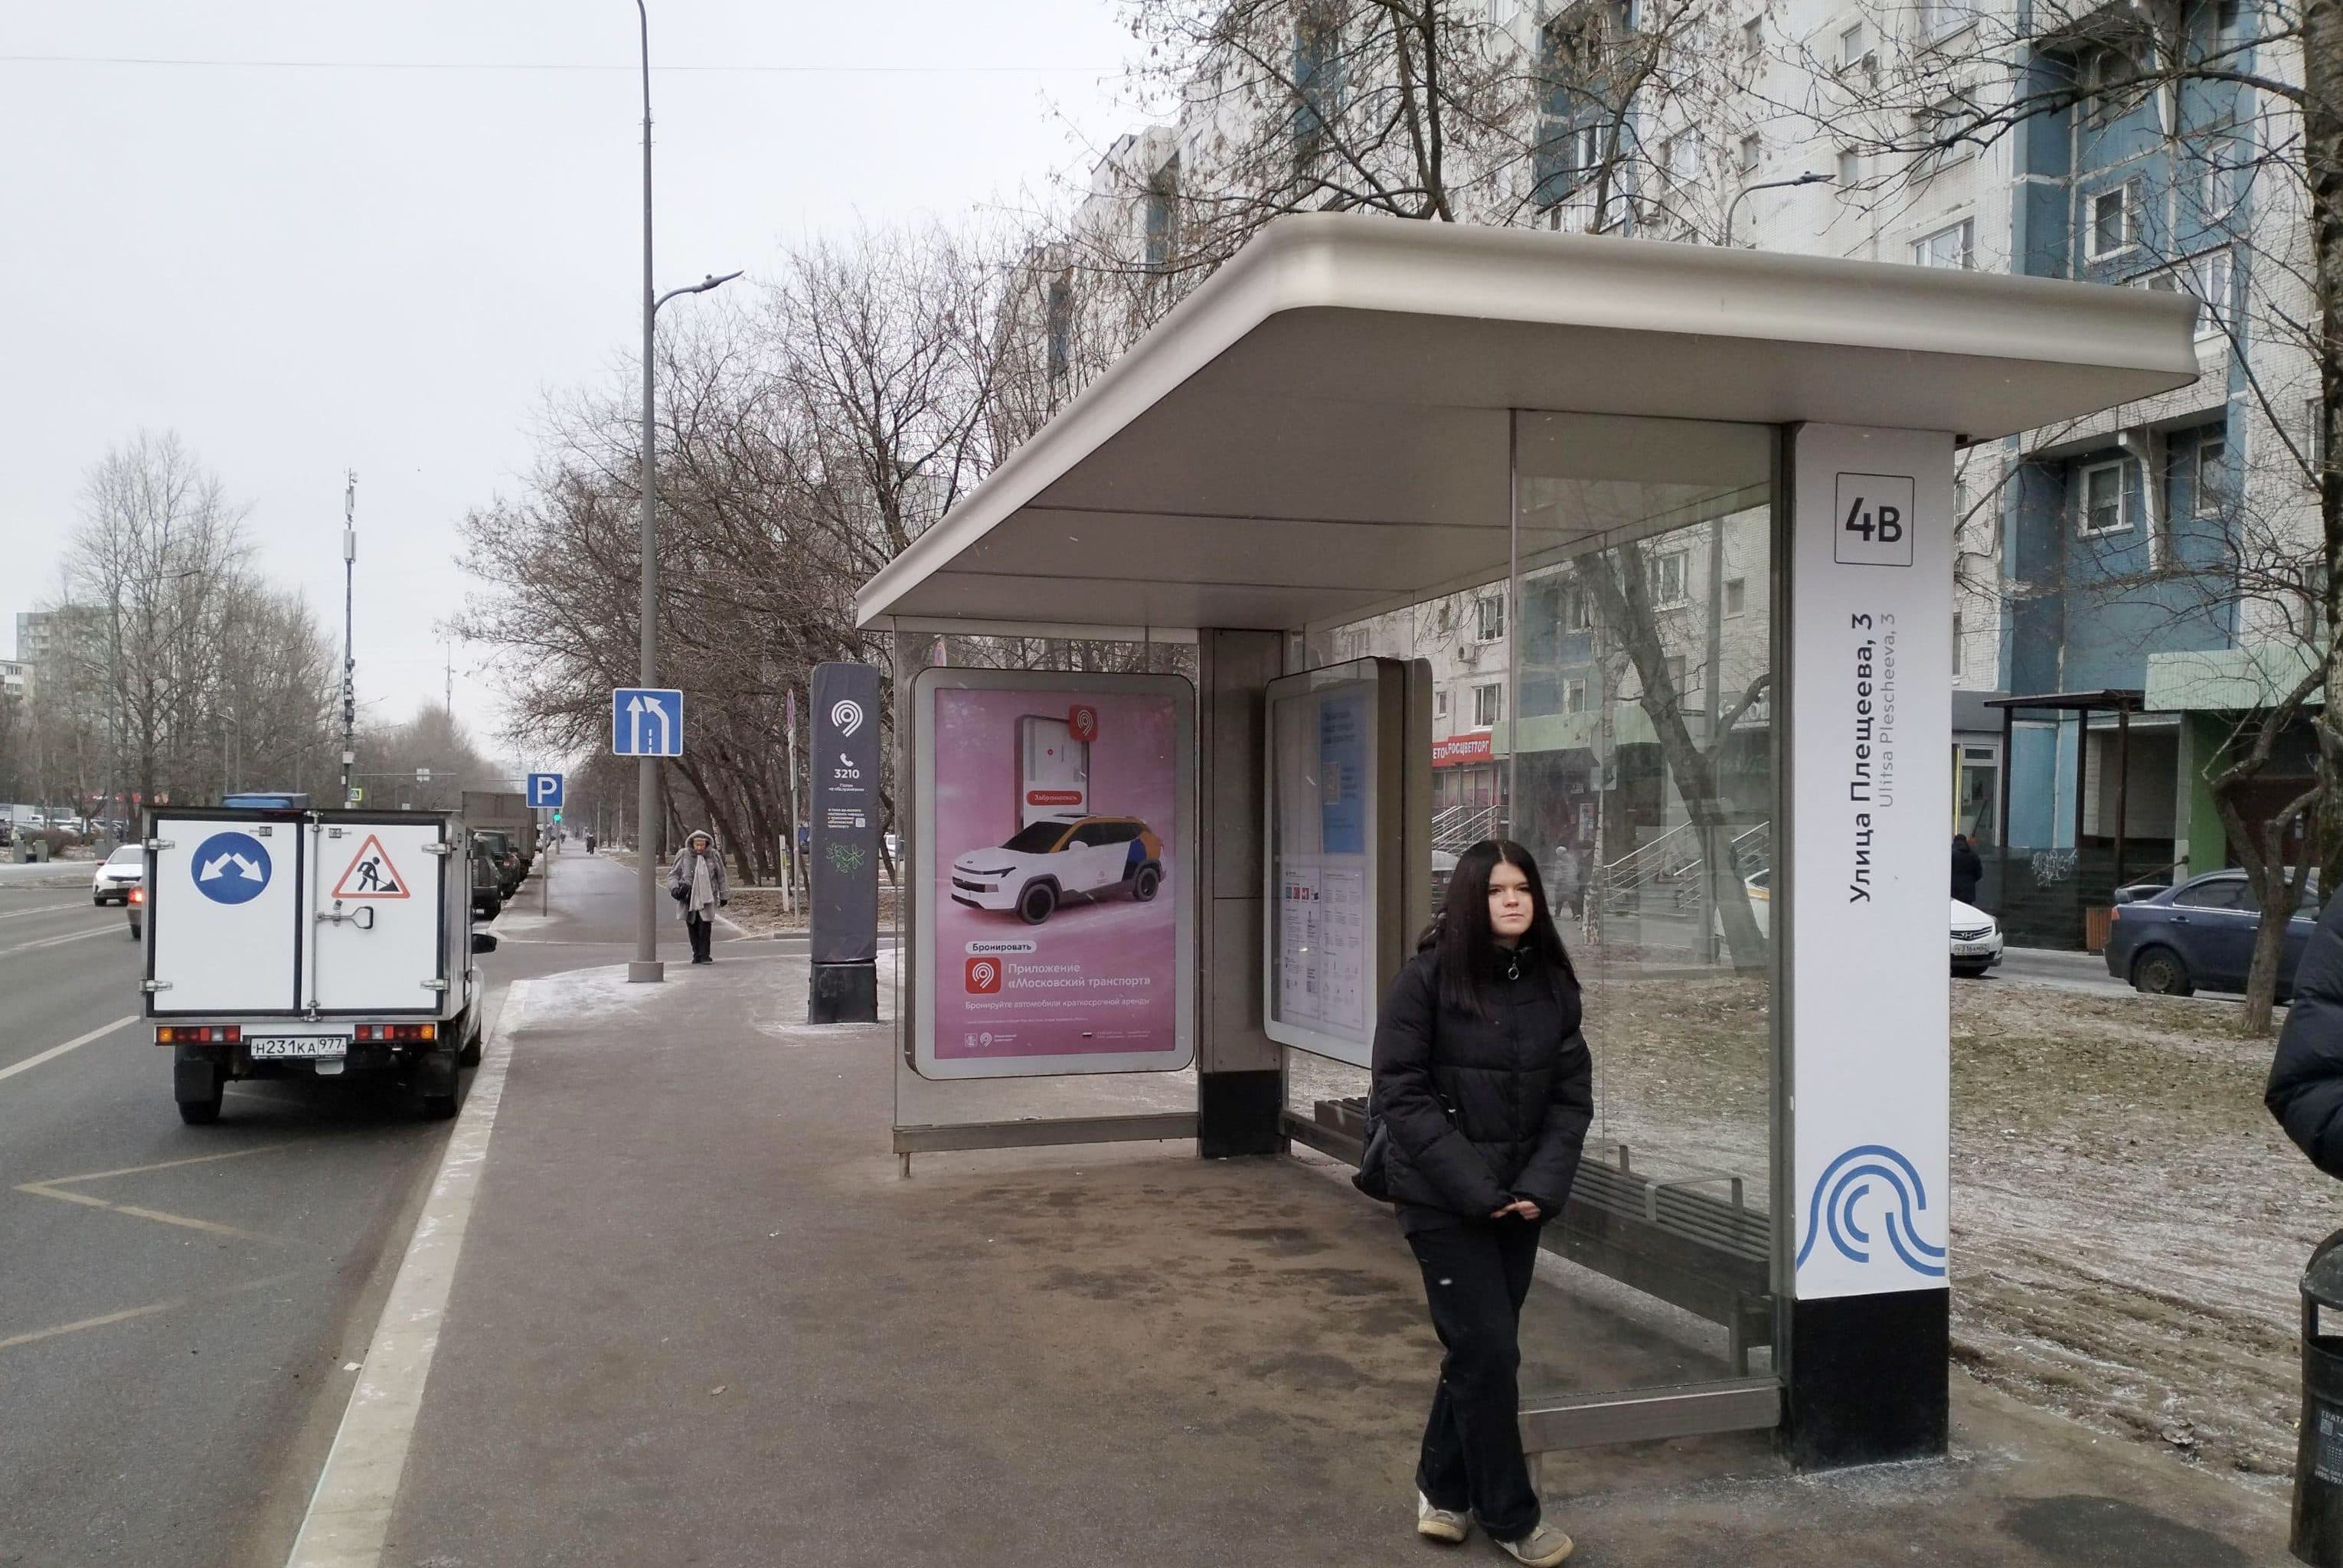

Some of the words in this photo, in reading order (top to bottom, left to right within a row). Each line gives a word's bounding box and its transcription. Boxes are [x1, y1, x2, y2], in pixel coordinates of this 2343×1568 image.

[1851, 613, 1873, 630] 3
[1881, 613, 1895, 625] 3
[1879, 631, 1897, 743] Plescheeva,
[1850, 639, 1877, 802] Плещеева,
[834, 769, 860, 779] 3210
[1878, 750, 1894, 807] Ulitsa
[537, 776, 557, 804] P
[1849, 813, 1874, 903] Улица
[972, 942, 1032, 952] Бронировать
[1008, 962, 1081, 975] Приложение
[1008, 977, 1085, 988] «Московский
[1087, 977, 1151, 988] транспорт»
[965, 1000, 1012, 1011] Бронируйте
[256, 1040, 316, 1054] Н231КА
[319, 1038, 342, 1049] 977
